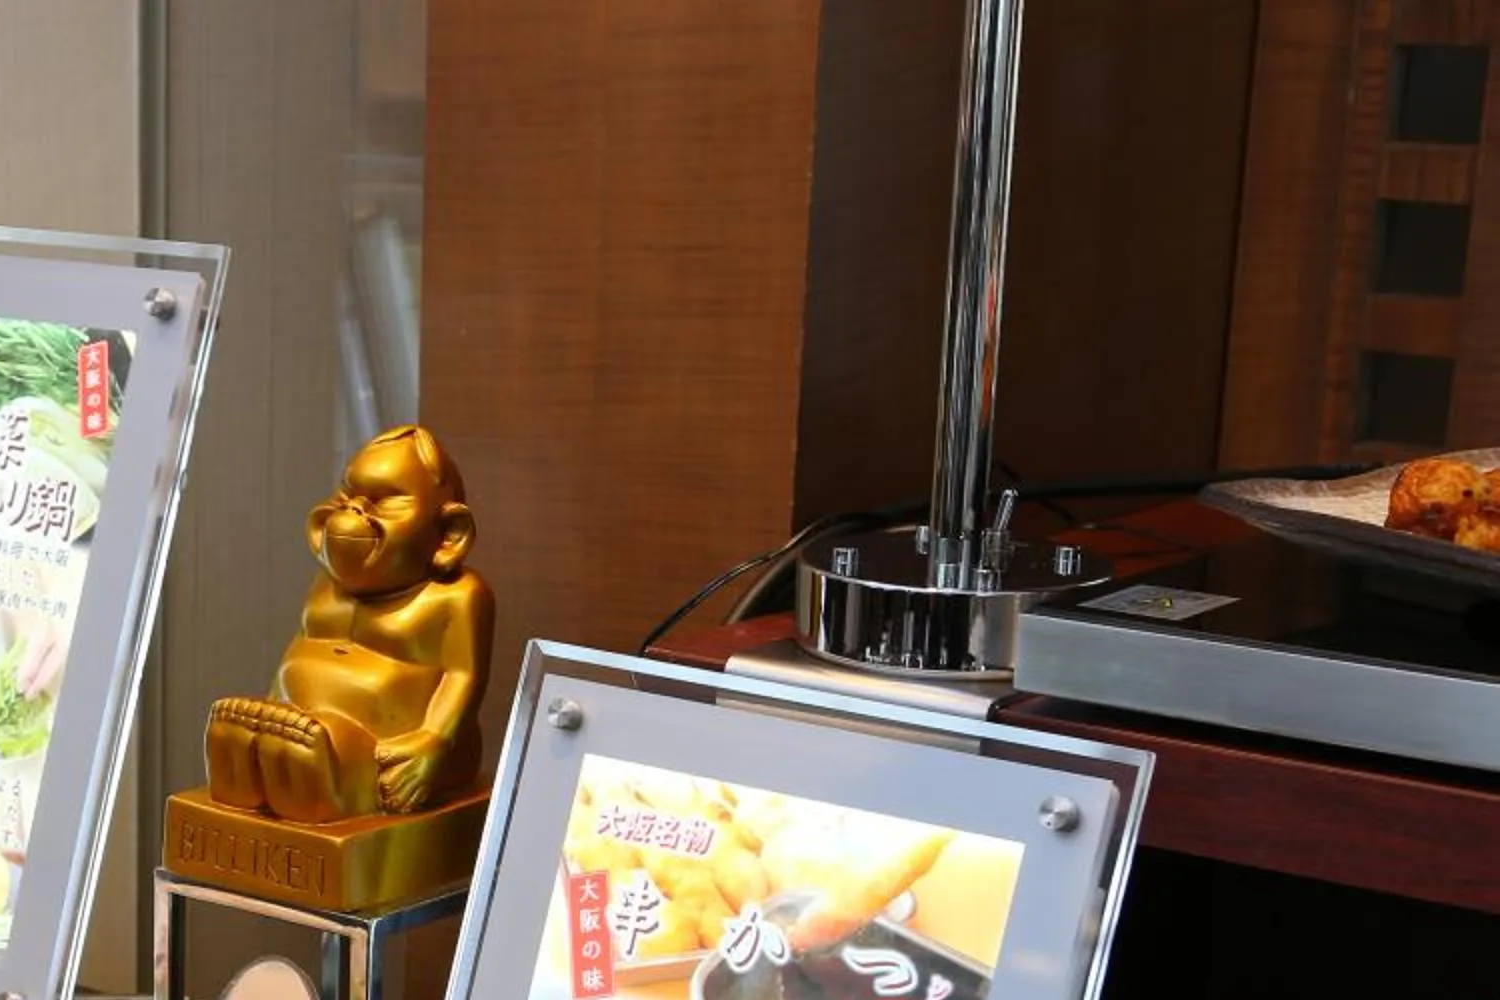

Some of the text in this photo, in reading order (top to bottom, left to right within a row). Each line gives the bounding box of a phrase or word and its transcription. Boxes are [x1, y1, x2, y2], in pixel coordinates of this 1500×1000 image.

[597, 806, 715, 856] 大阪名物
[576, 878, 605, 991] 大阪の味
[613, 878, 917, 995] 串かつ
